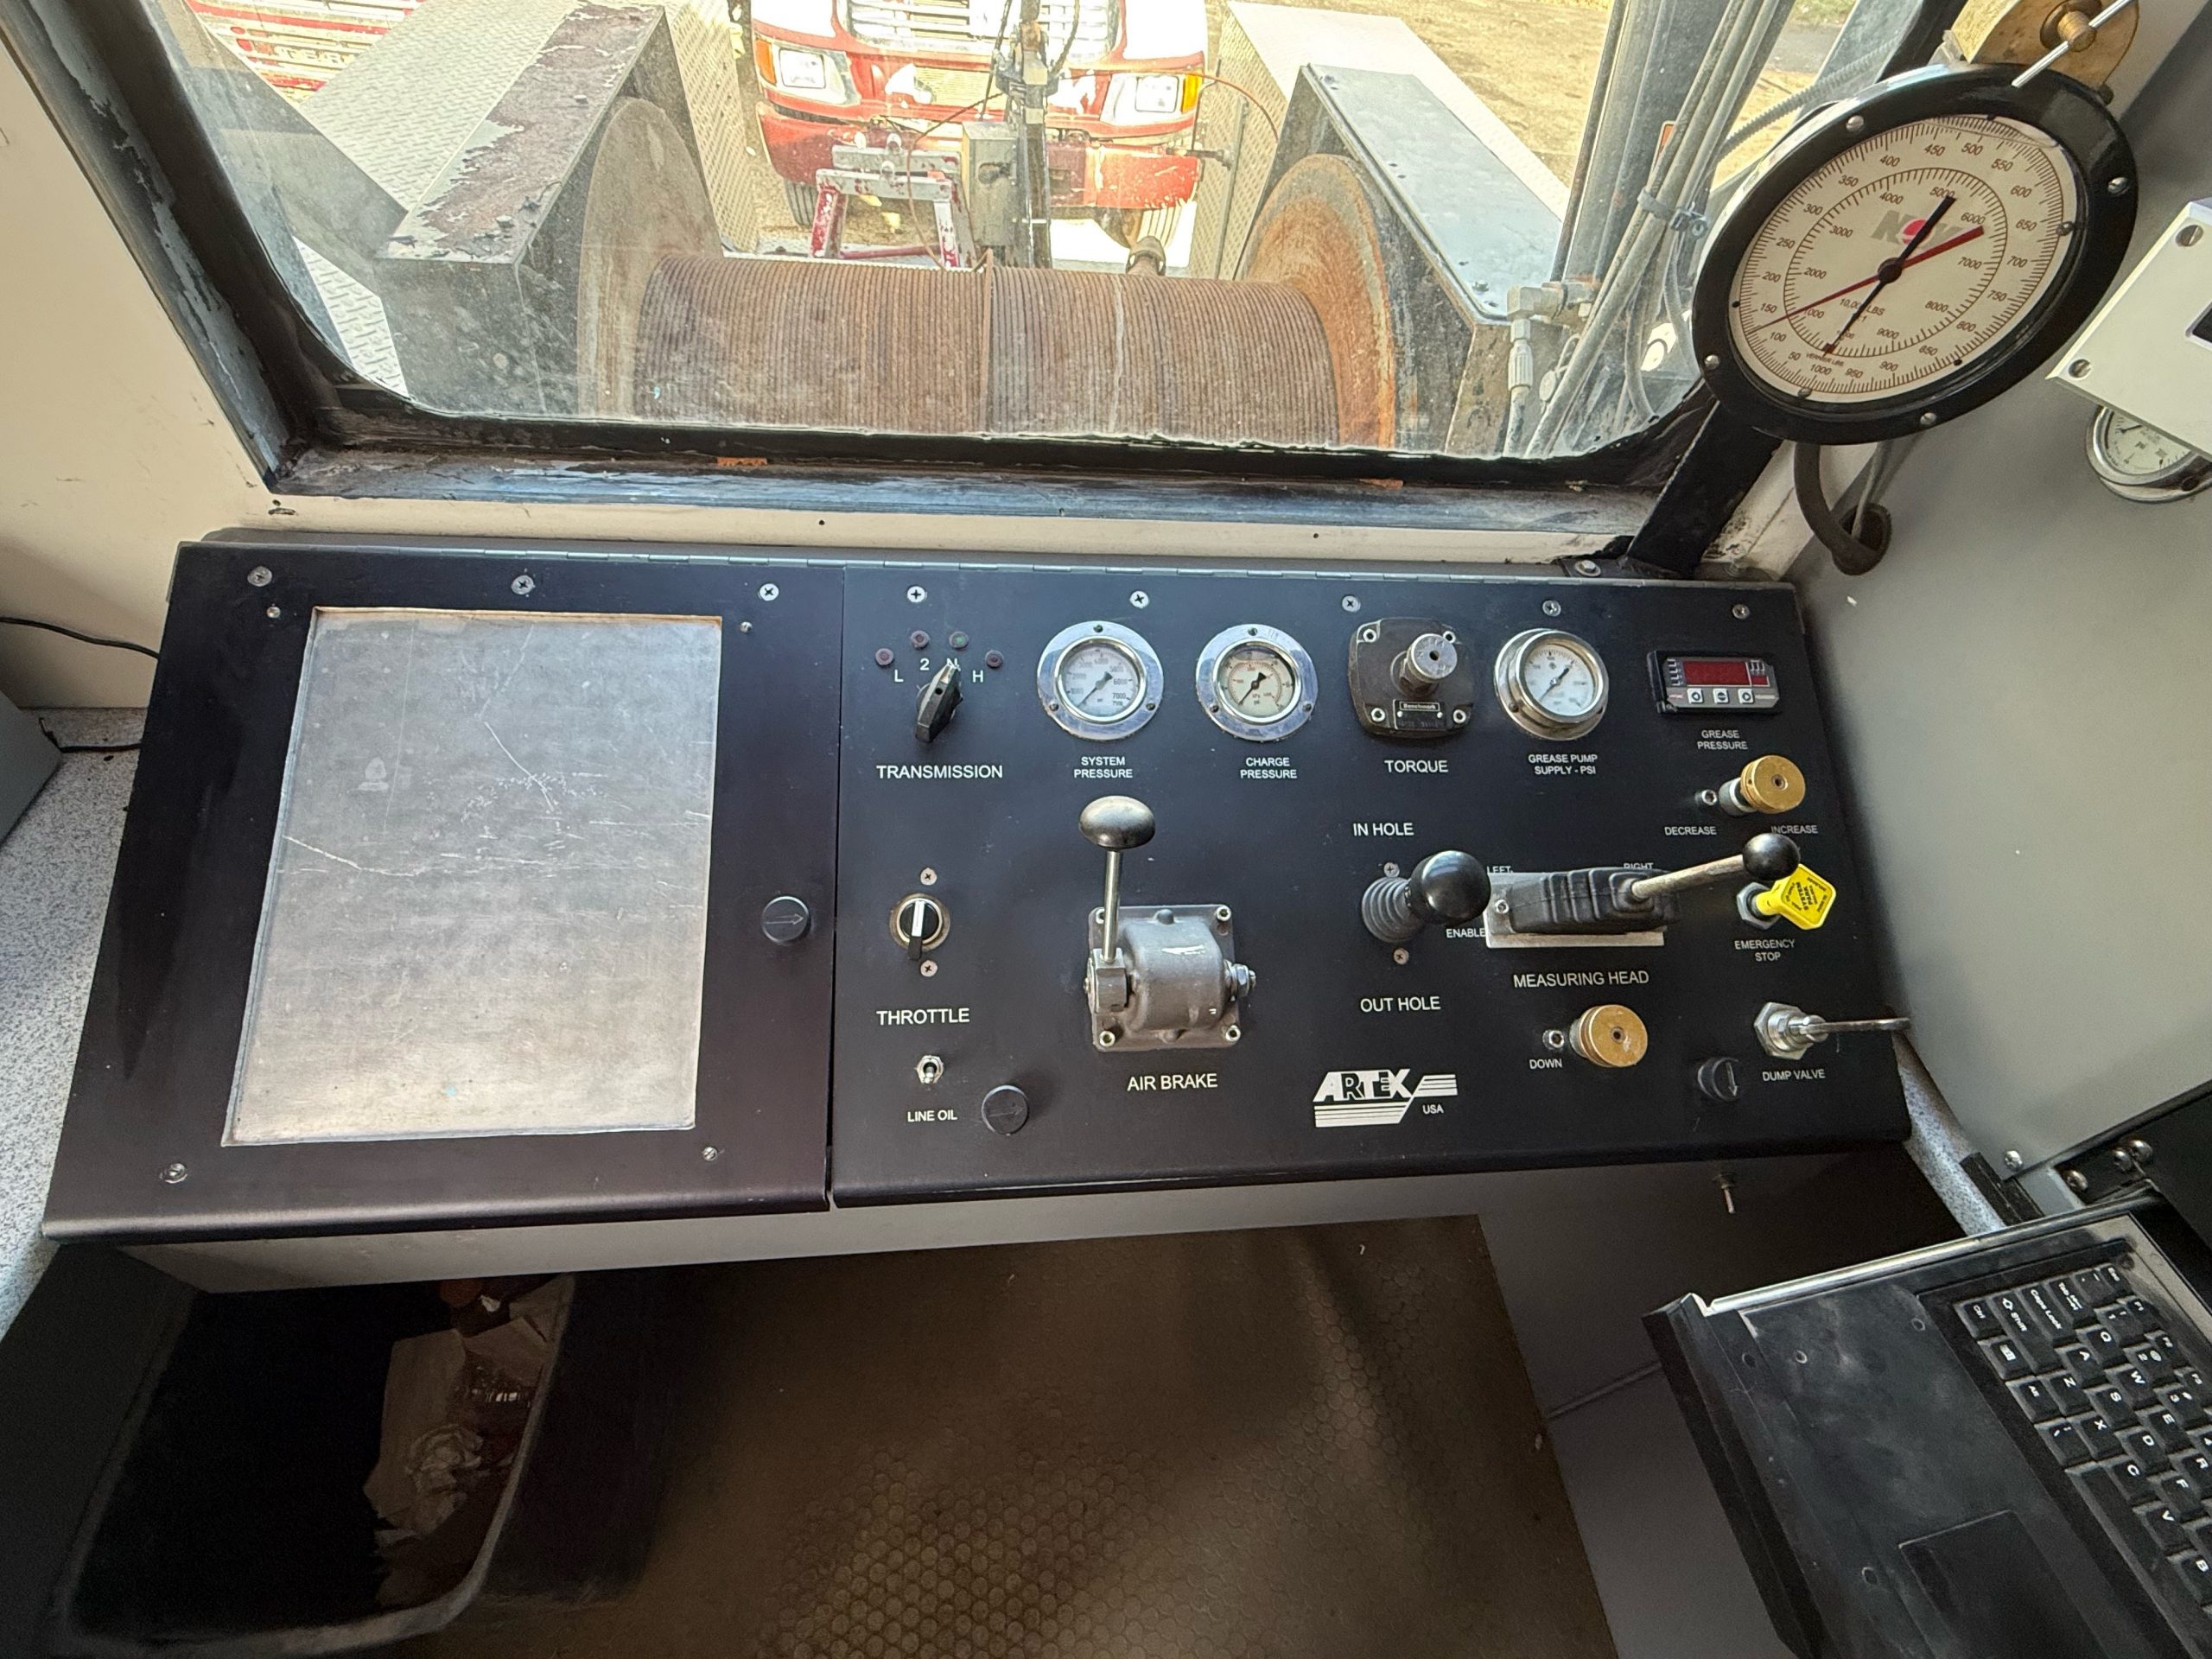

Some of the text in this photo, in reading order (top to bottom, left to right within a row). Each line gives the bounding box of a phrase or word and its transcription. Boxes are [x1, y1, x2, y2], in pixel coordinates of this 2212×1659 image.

[1924, 143, 1945, 156] 450
[1961, 143, 1983, 156] 500
[1880, 155, 1901, 167] 400
[1991, 158, 2013, 171] 550
[1838, 175, 1859, 187] 350
[2010, 185, 2031, 198] 600
[1879, 192, 1904, 205] 4000
[1803, 203, 1823, 215] 300
[1961, 212, 1986, 225] 6000
[2016, 219, 2037, 232] 650
[1829, 226, 1853, 238] 3000
[1776, 237, 1796, 249] 250
[1957, 256, 1983, 270] 7000
[2006, 256, 2028, 268] 700
[1762, 271, 1781, 283] 200
[1804, 267, 1827, 279] 2000
[1986, 290, 2007, 302] 750
[1760, 302, 1777, 314] 150
[1924, 301, 1948, 313] 8000
[1956, 321, 1976, 333] 800
[1770, 332, 1786, 342] 100
[1876, 327, 1899, 340] 9000
[1788, 352, 1801, 361] 50
[1918, 345, 1938, 356] 850
[1810, 364, 1832, 376] 1000
[1845, 367, 1864, 378] 950
[1879, 361, 1898, 372] 900
[919, 658, 930, 671] 2
[894, 670, 904, 683] L
[972, 671, 983, 683] H
[1701, 729, 1740, 739] GREASE
[1697, 741, 1748, 750] PRESSURE
[1081, 756, 1126, 766] SYSTEM
[1245, 757, 1291, 767] CHARGE
[1528, 753, 1599, 764] GREASE PUMP
[876, 765, 1003, 779] TRANSMISSION
[1384, 760, 1449, 773] TORQUE
[1534, 766, 1573, 775] SUPPLY
[1580, 766, 1597, 775] PSI
[1074, 768, 1134, 779] PRESSURE
[1240, 769, 1298, 779] PRESSURE
[1353, 823, 1414, 836] IN HOLE
[1664, 826, 1717, 836] DECREASE
[1771, 824, 1819, 834] INCREASE
[1446, 927, 1486, 938] ENABLE
[1734, 938, 1796, 950] EMERGENCY
[1754, 951, 1781, 962] STOP
[1513, 970, 1649, 988] MEASURING HEAD
[1360, 996, 1441, 1013] OUT HOLE
[876, 1007, 970, 1026] THROTTLE
[1529, 1058, 1563, 1070] DOWN
[1763, 1068, 1826, 1082] DUMP VALVE
[1127, 1073, 1218, 1091] AIR BRAKE
[1313, 1068, 1413, 1103] ARTEK
[907, 1109, 958, 1122] LINE OIL
[1422, 1104, 1444, 1115] USA
[1974, 1305, 1986, 1319] Ctrl
[2031, 1288, 2063, 1330] Caps Lock
[2011, 1312, 2027, 1332] Shift
[2101, 1331, 2112, 1343] Q
[2079, 1351, 2090, 1361] A
[2063, 1377, 2076, 1388] Z
[2131, 1370, 2145, 1384] W
[2109, 1391, 2121, 1402] S
[2170, 1394, 2180, 1403] 3
[2094, 1419, 2107, 1431] X
[2162, 1414, 2176, 1425] E
[2142, 1434, 2155, 1446] D
[2196, 1457, 2209, 1469] R
[2126, 1465, 2139, 1477] C
[2177, 1478, 2189, 1489] F
[2162, 1510, 2175, 1521] V
[2196, 1560, 2209, 1573] B
